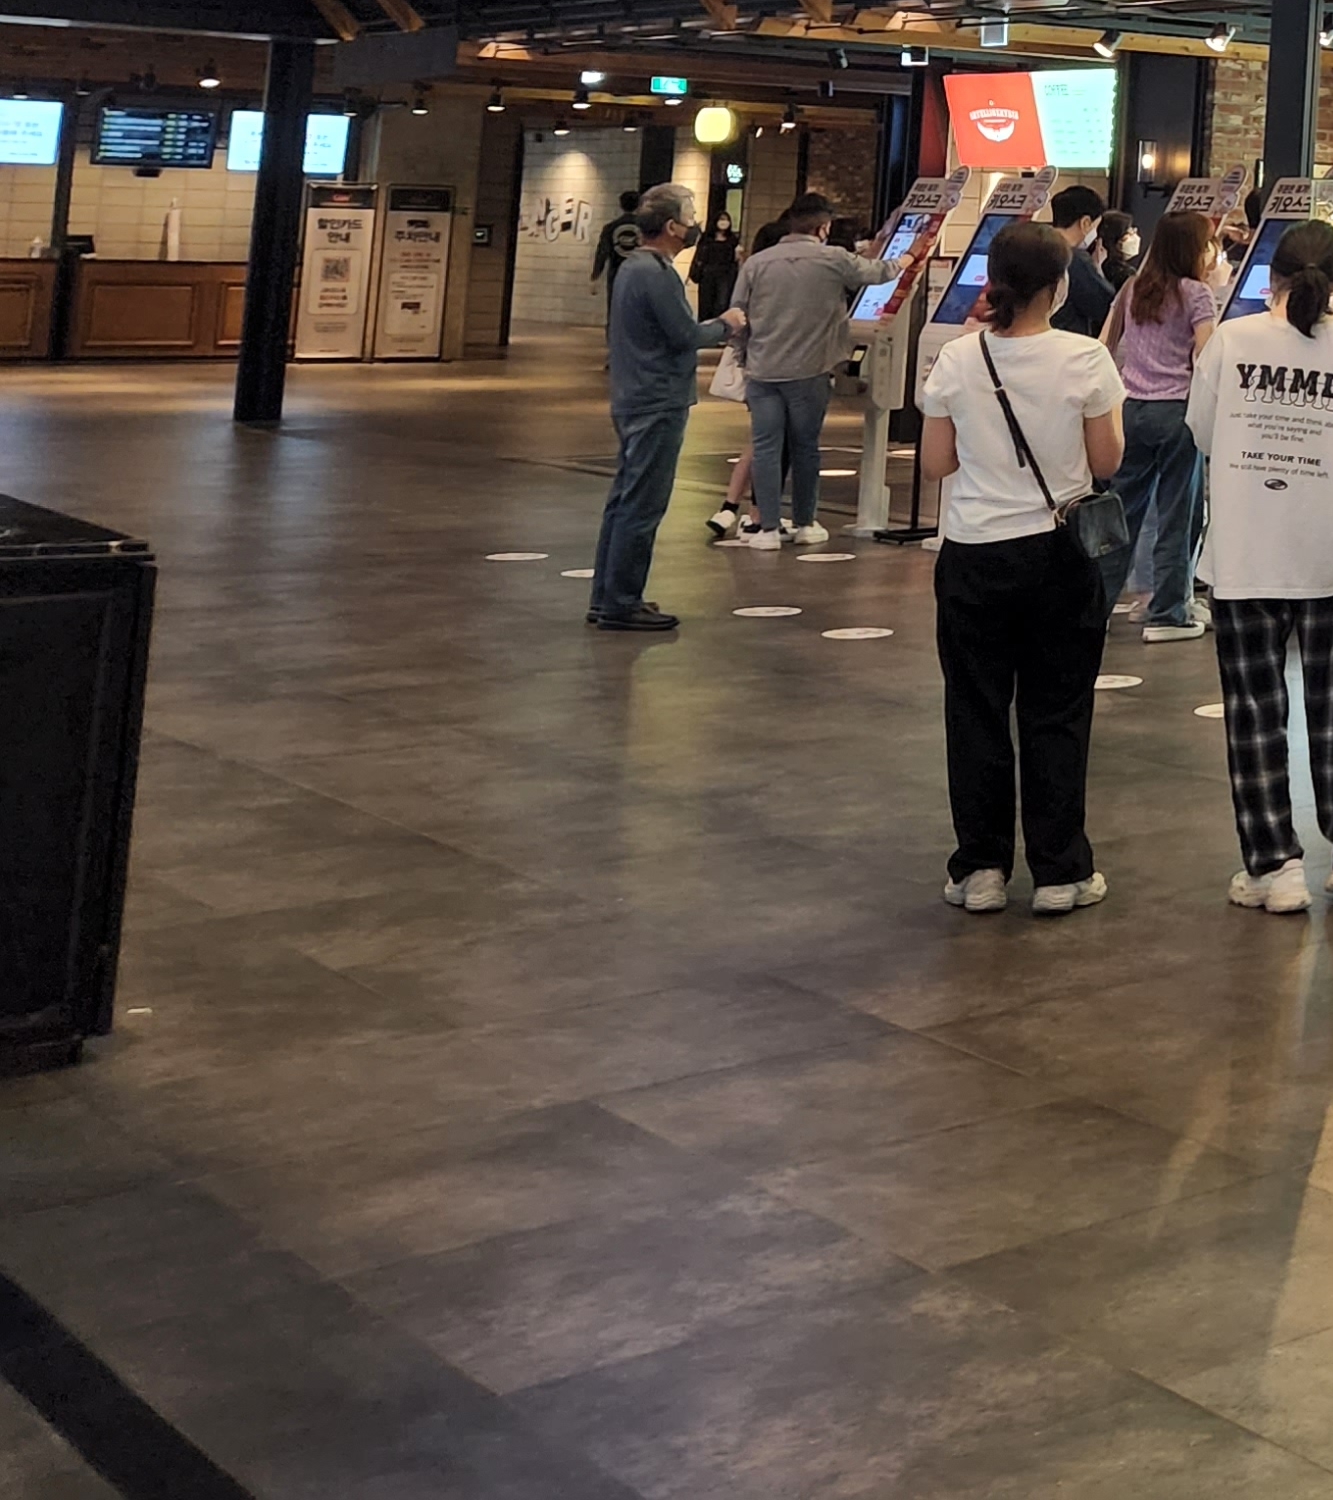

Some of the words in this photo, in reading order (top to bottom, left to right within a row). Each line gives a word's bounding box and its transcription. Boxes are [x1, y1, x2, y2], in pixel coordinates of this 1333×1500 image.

[1170, 196, 1215, 211] 키오스크
[327, 232, 351, 244] 안내
[1309, 428, 1322, 436] and
[1241, 451, 1265, 461] TAKE
[1267, 452, 1294, 463] YOUR
[1297, 456, 1322, 467] TIME
